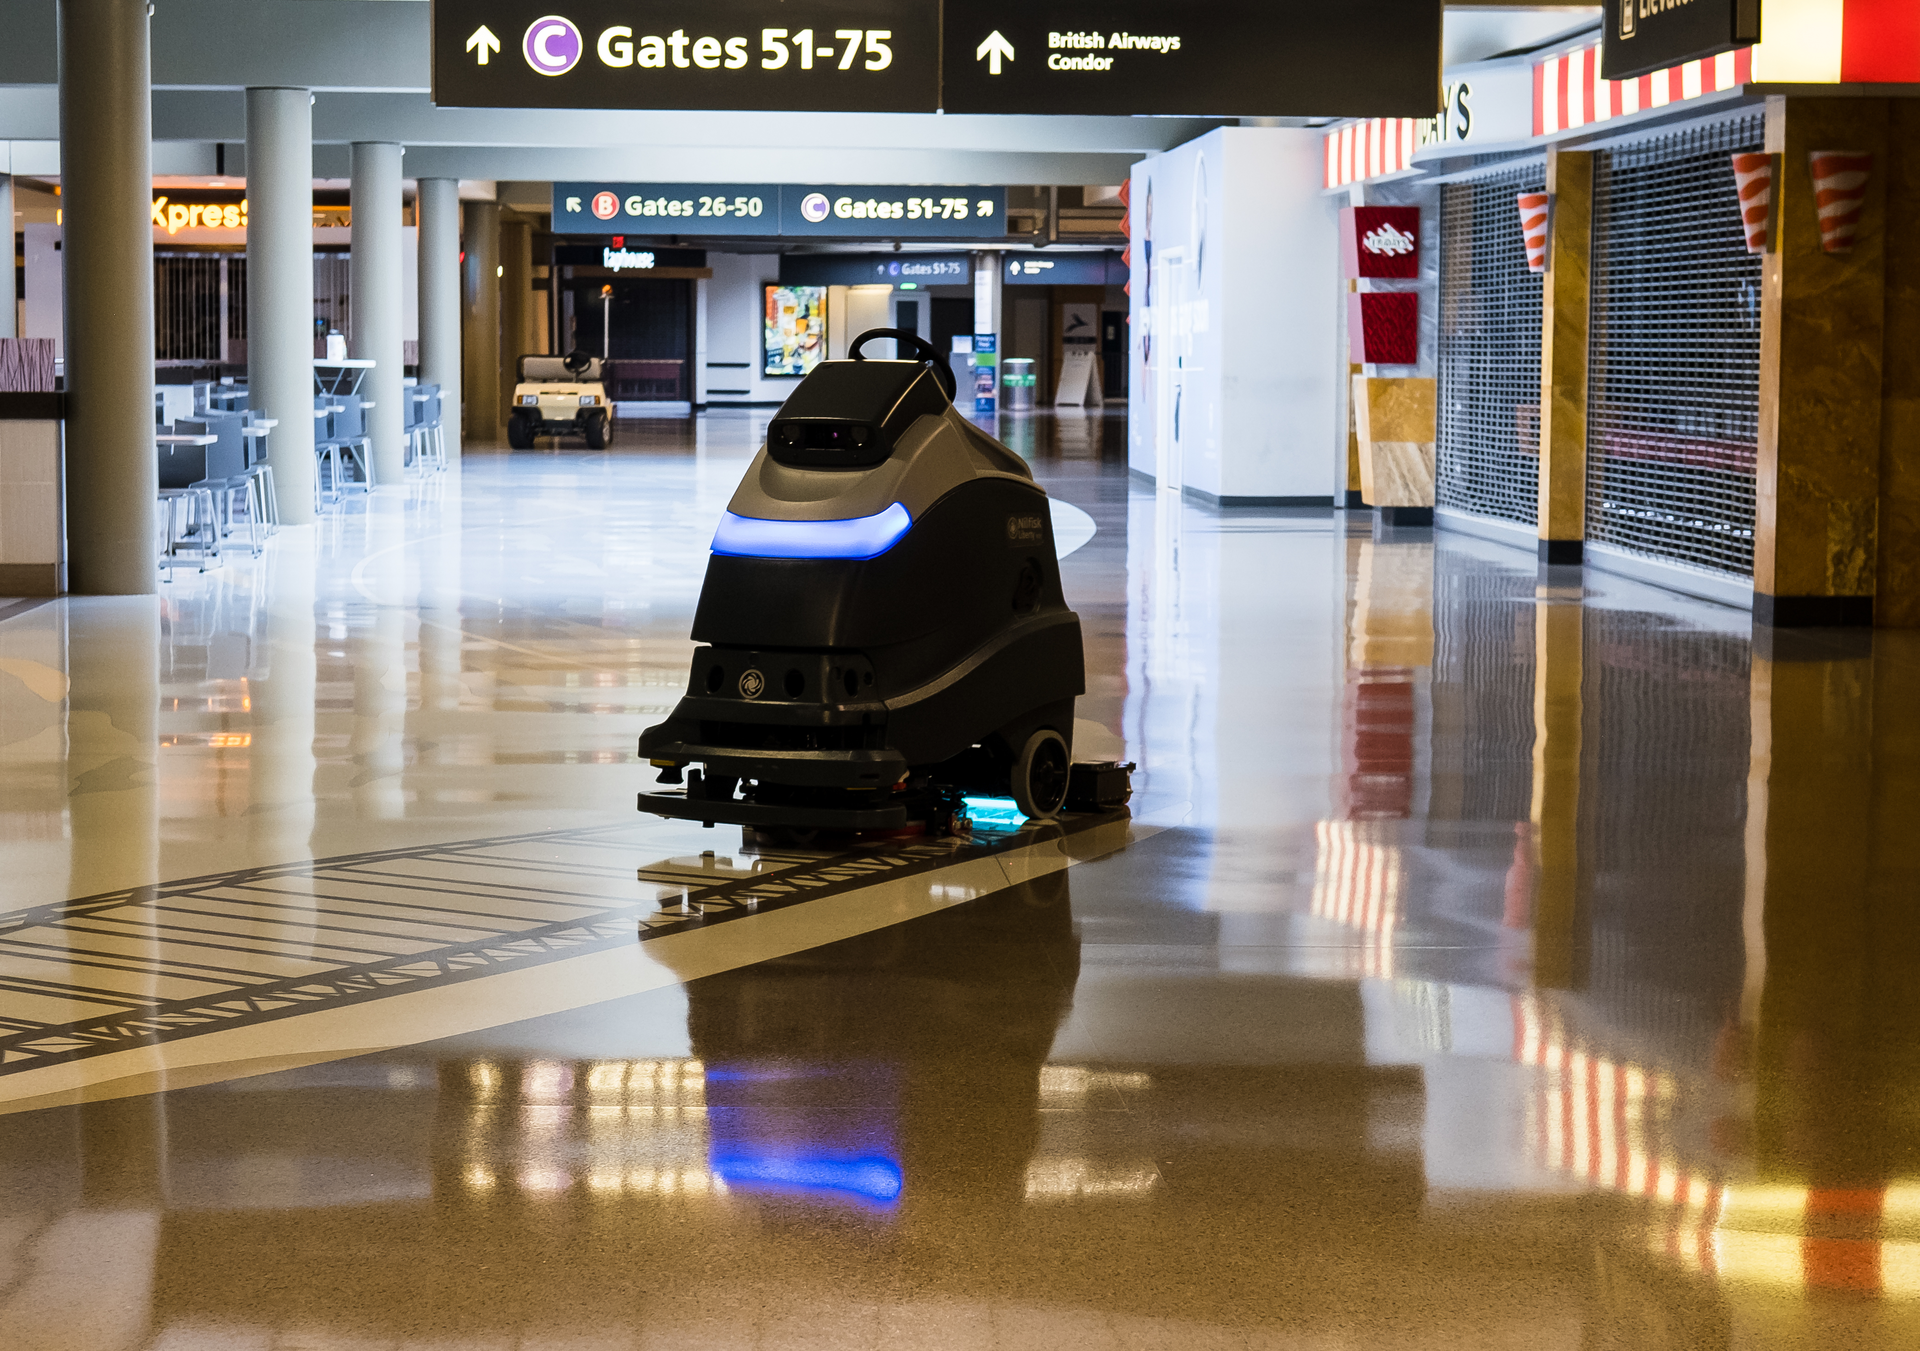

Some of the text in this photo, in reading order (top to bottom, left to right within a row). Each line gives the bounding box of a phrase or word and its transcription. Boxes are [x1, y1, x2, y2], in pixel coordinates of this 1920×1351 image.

[533, 25, 893, 71] C Gates 51-75
[1048, 31, 1181, 53] British Airways
[1048, 52, 1114, 70] Condor
[598, 195, 763, 217] B Gates 26-50
[805, 197, 969, 219] C Gates 51-75
[901, 263, 931, 275] Gates
[932, 262, 961, 274] 51-75
